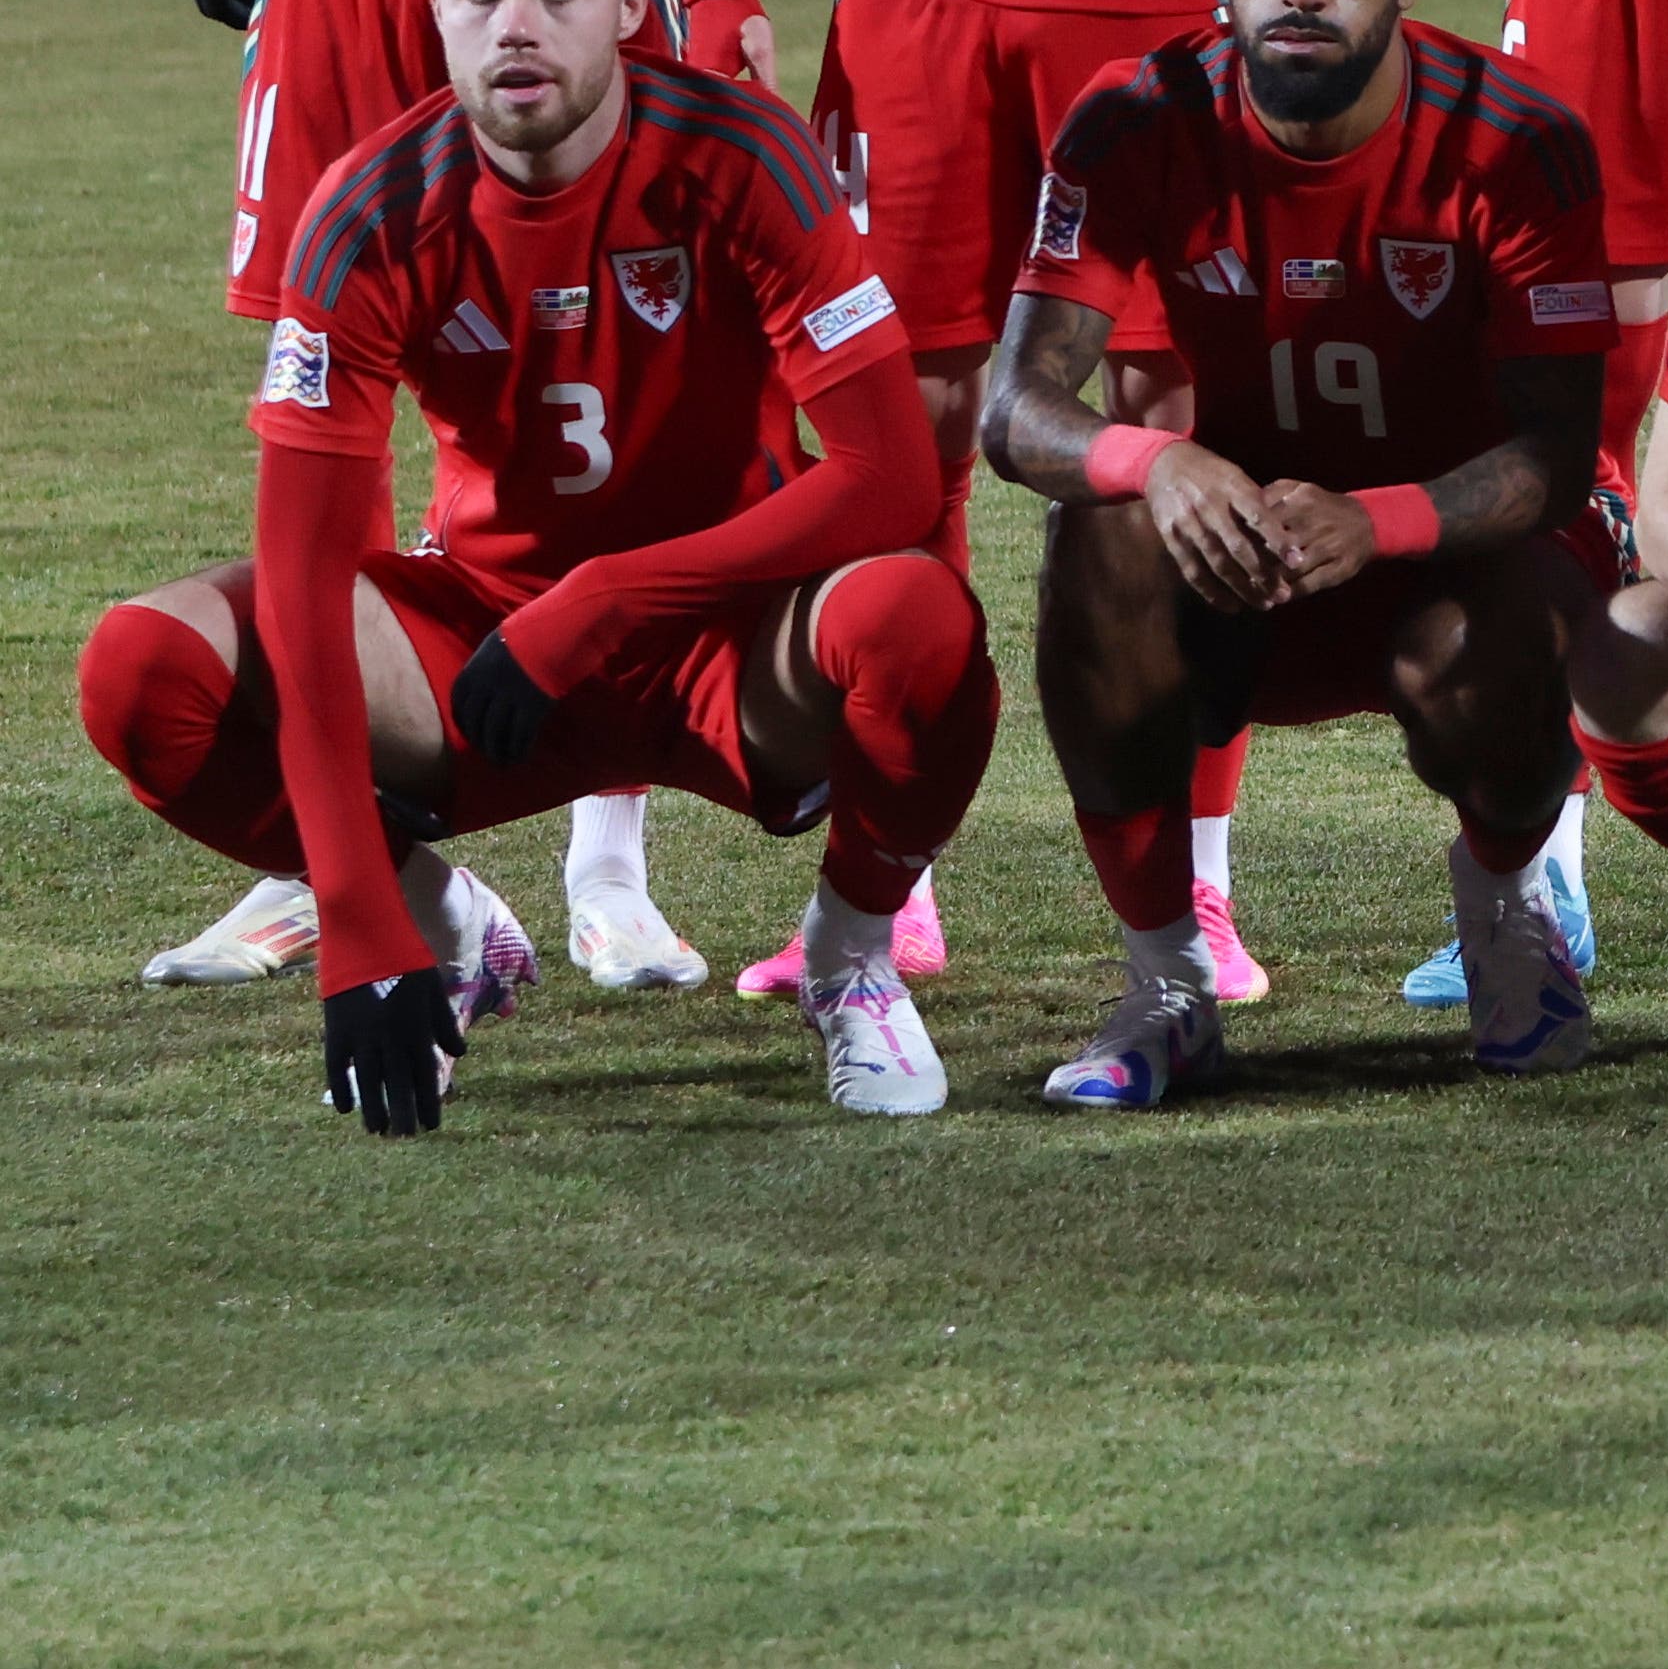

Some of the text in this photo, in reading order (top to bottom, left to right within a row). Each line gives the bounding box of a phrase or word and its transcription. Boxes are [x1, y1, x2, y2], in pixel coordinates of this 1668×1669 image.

[239, 78, 278, 201] 11
[542, 383, 614, 495] 3
[1269, 340, 1387, 438] 19
